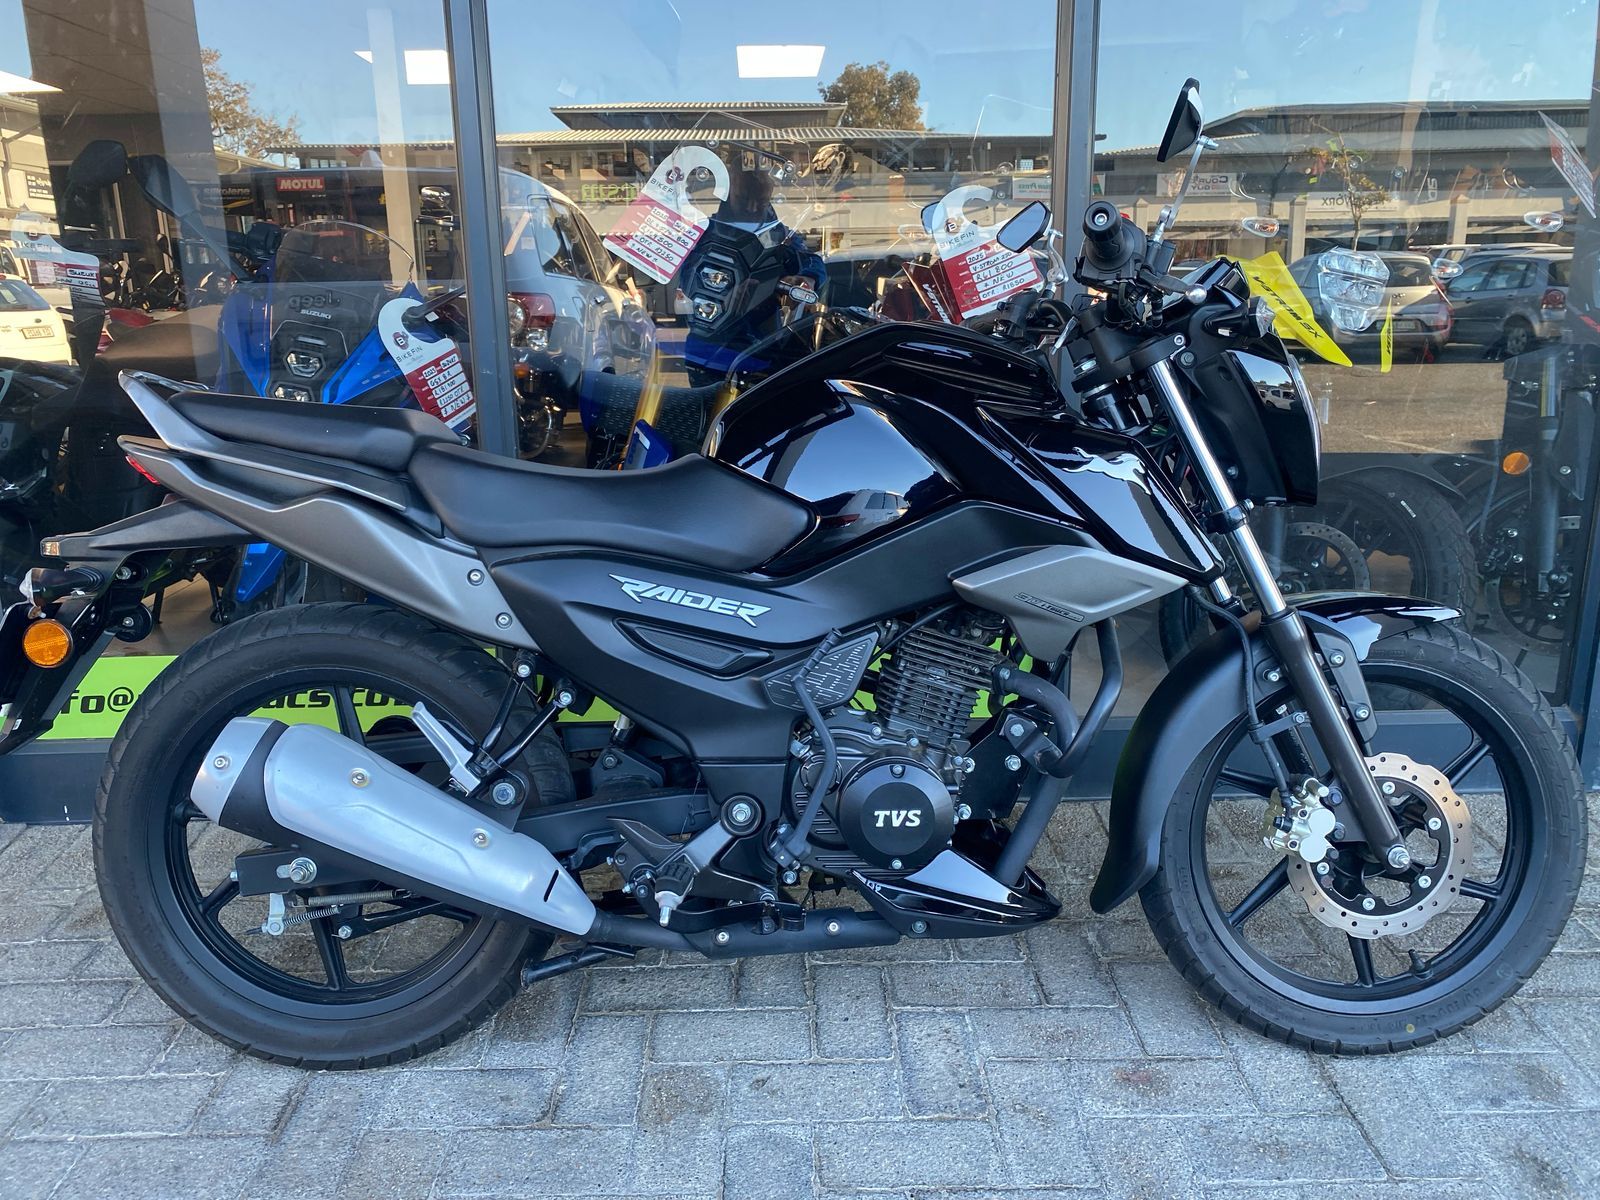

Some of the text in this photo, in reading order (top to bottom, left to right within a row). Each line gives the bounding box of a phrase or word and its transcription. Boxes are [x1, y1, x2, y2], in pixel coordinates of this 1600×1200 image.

[280, 179, 323, 189] MOTUL
[650, 178, 680, 199] BIKEFI
[967, 253, 985, 264] 2025
[995, 261, 1014, 273] 800
[992, 271, 1014, 284] NEW
[300, 308, 332, 320] SUZUKI
[1299, 321, 1324, 339] SX
[395, 345, 423, 362] BIKEFIN
[608, 573, 772, 628] RAIDER
[874, 809, 921, 828] TVS
